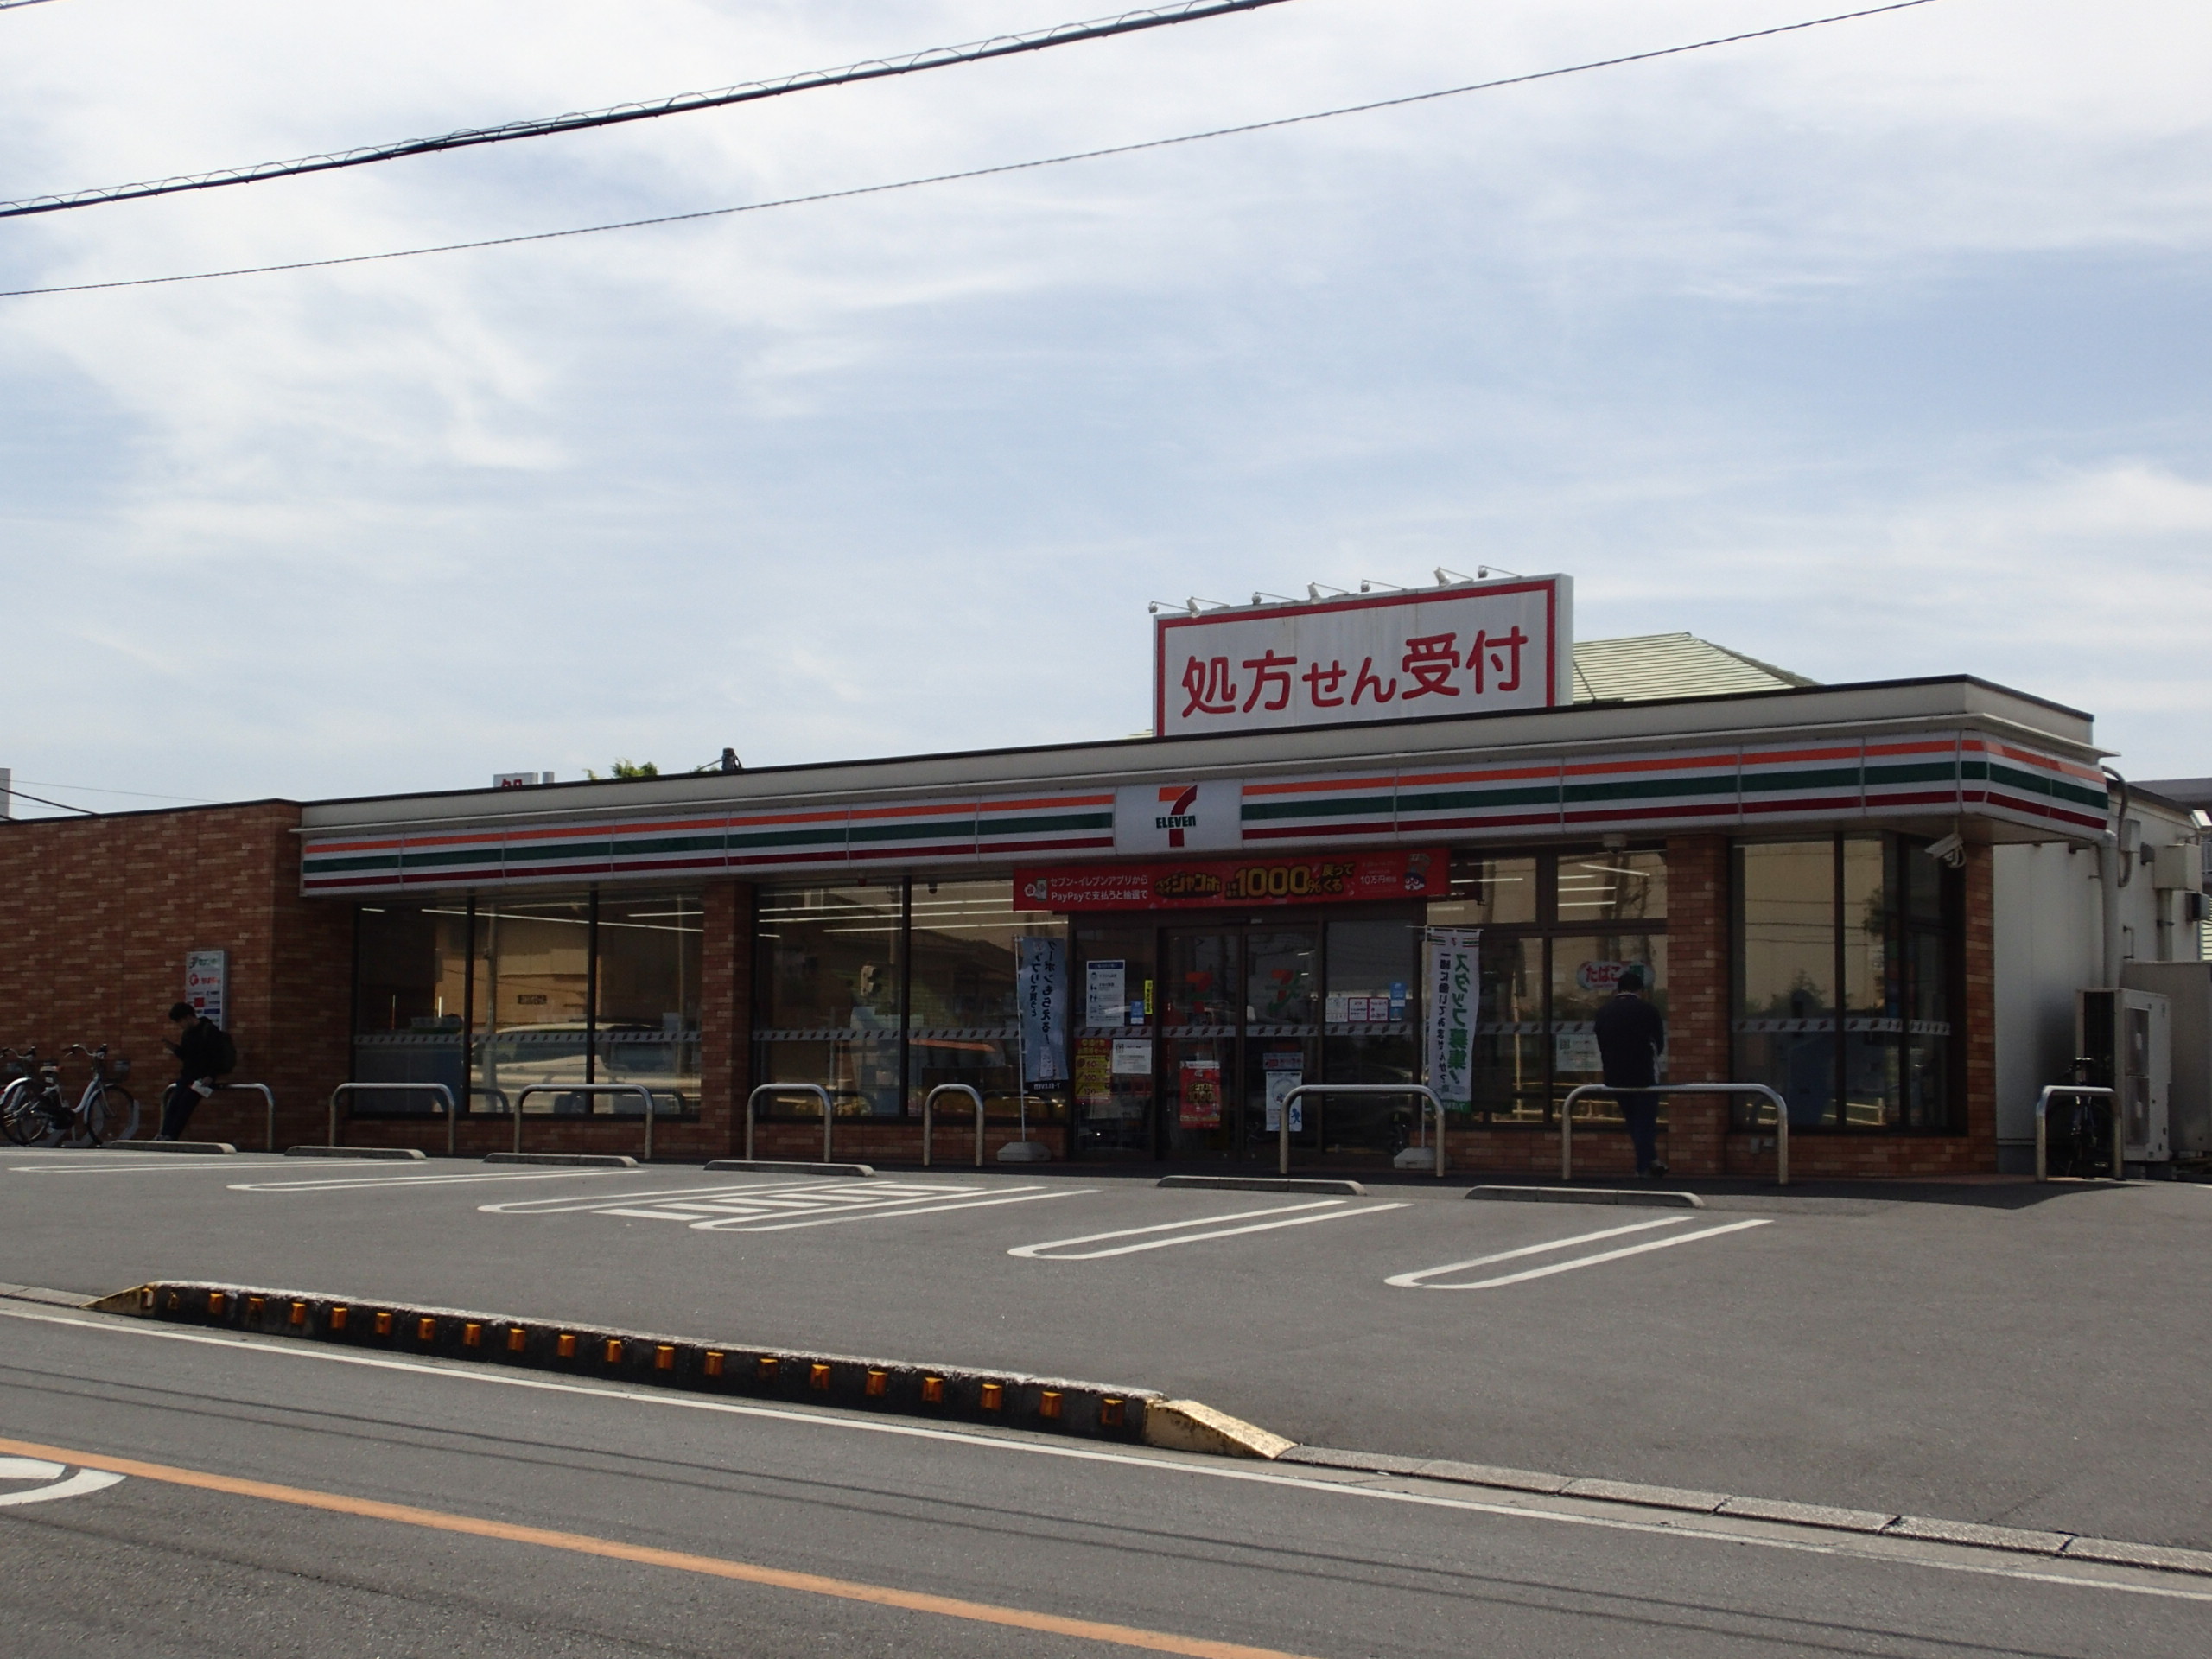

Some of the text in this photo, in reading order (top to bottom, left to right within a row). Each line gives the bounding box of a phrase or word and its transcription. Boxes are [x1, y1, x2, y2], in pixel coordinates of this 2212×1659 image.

[1181, 625, 1529, 718] 処方せん受付
[1322, 864, 1354, 878] 戻って
[1322, 877, 1344, 893] くる
[1586, 965, 1624, 983] たばこ
